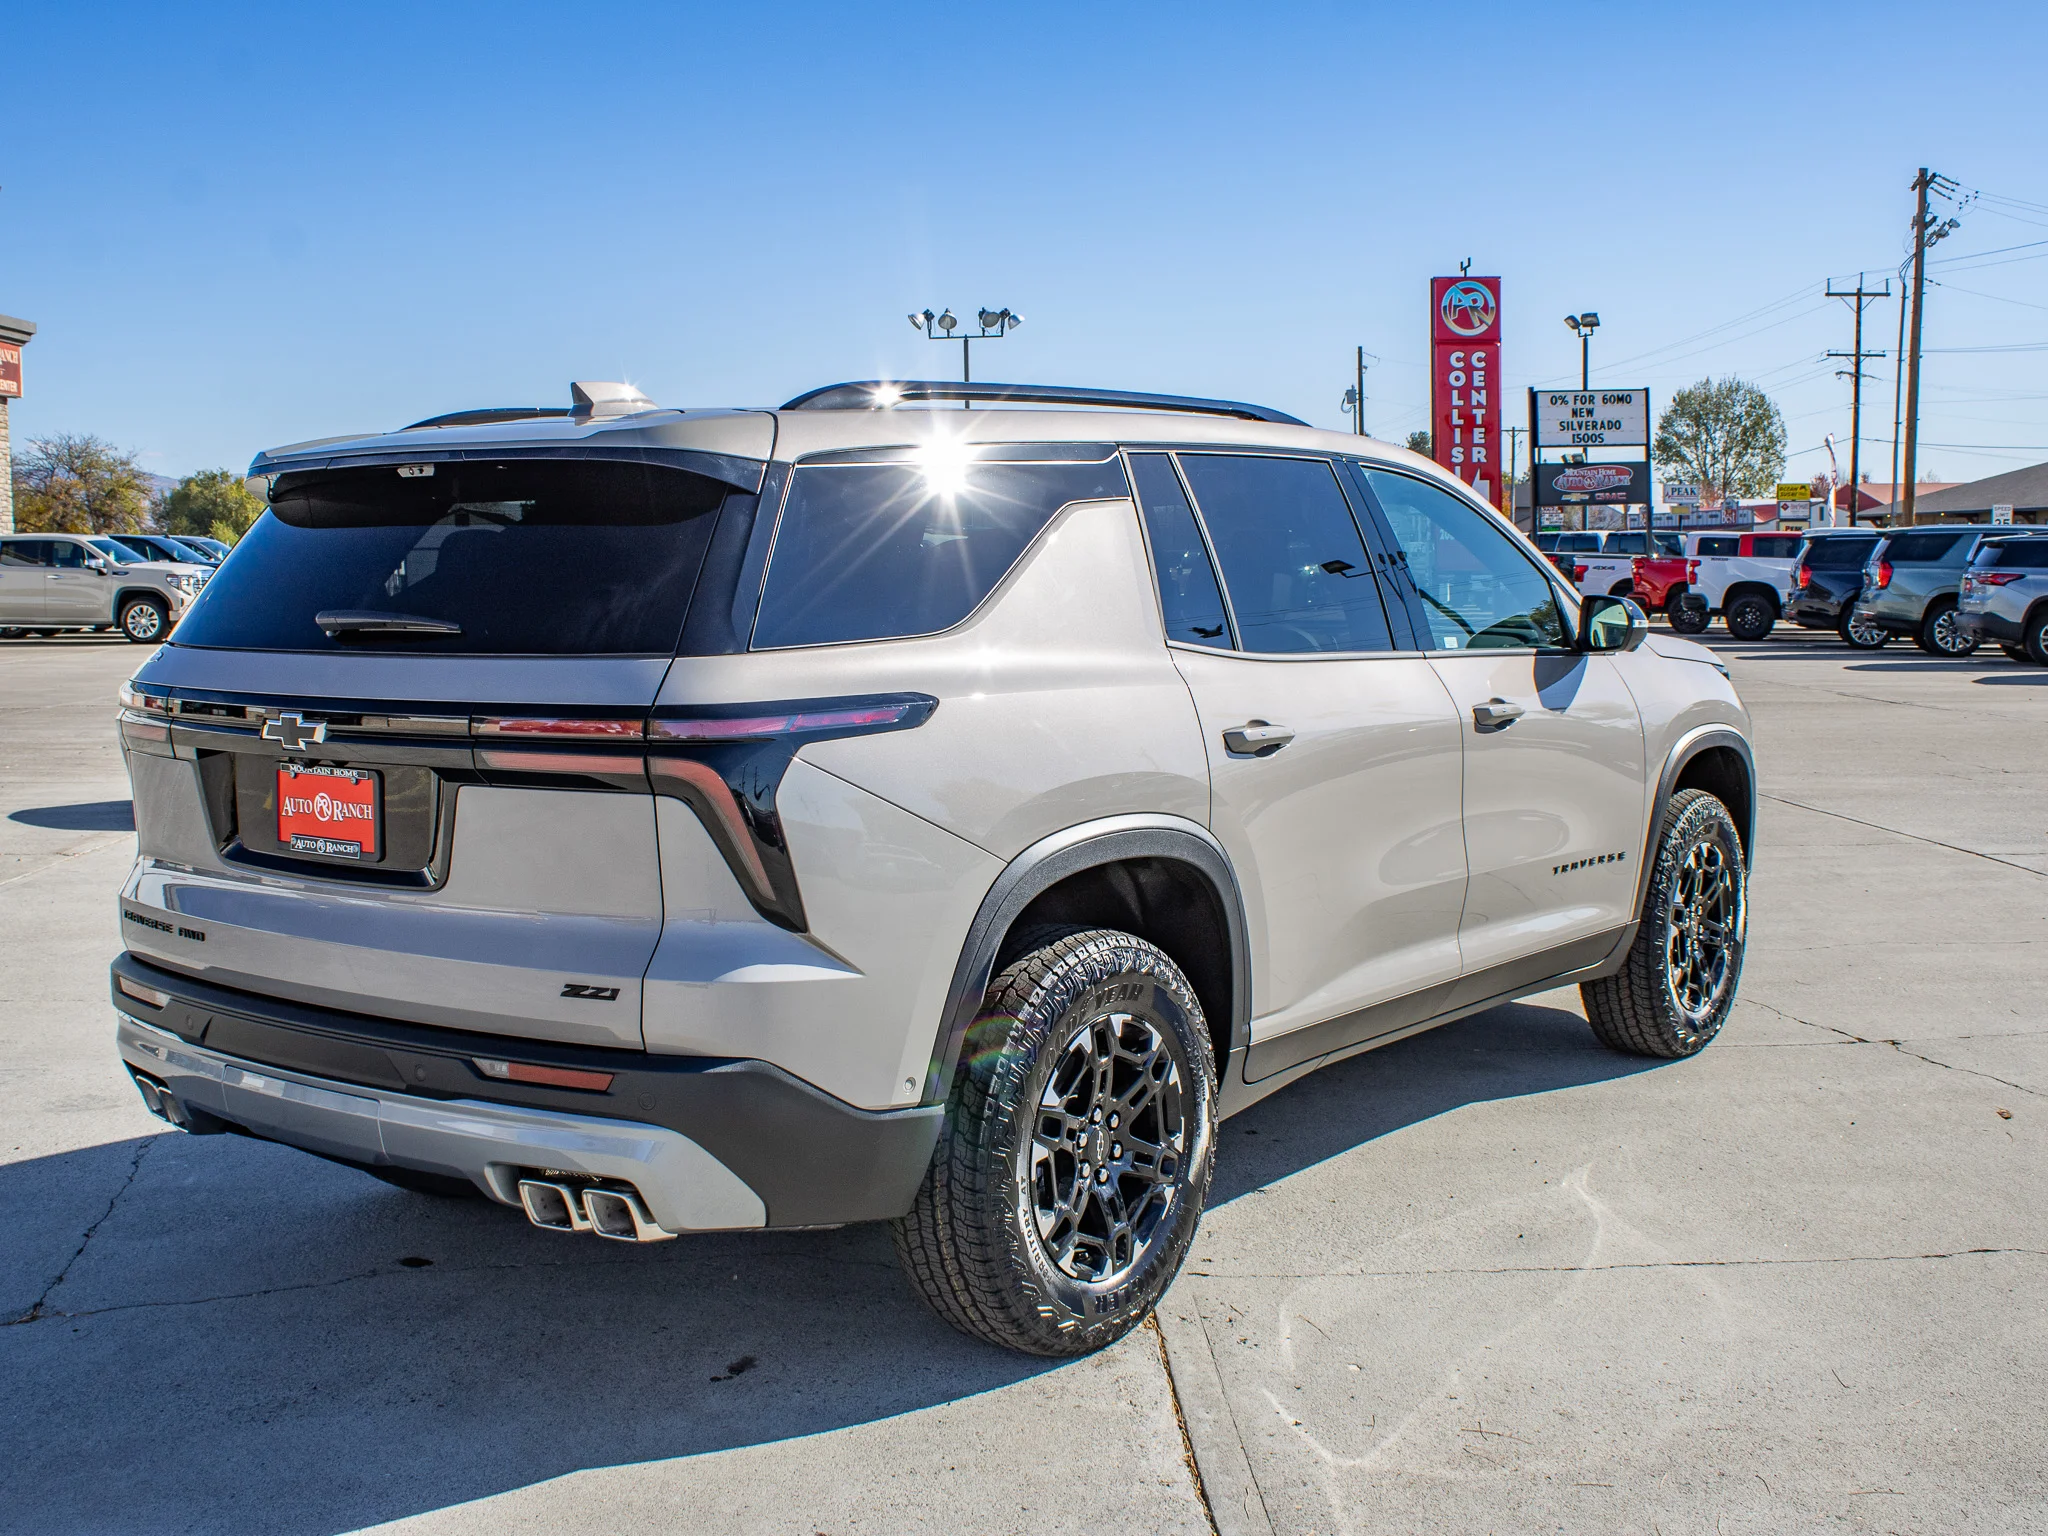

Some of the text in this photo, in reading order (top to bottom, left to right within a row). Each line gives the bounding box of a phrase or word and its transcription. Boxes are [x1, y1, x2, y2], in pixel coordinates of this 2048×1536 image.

[1470, 351, 1488, 463] CENTER
[1550, 394, 1633, 406] 0% FOR 60MO
[1449, 351, 1467, 480] COLLISI
[1571, 407, 1594, 418] NEW
[1559, 420, 1621, 431] SILVERADO
[1572, 433, 1605, 444] 1500S
[1595, 492, 1627, 500] GMC
[1671, 487, 1697, 496] PEAK
[289, 764, 359, 778] MOUNTAIN HOME
[281, 796, 313, 817] AUTO
[332, 800, 373, 821] RANCH
[295, 839, 354, 853] AUTO RANCH
[1551, 851, 1626, 876] TRAVERSE
[560, 984, 621, 1001] Z71
